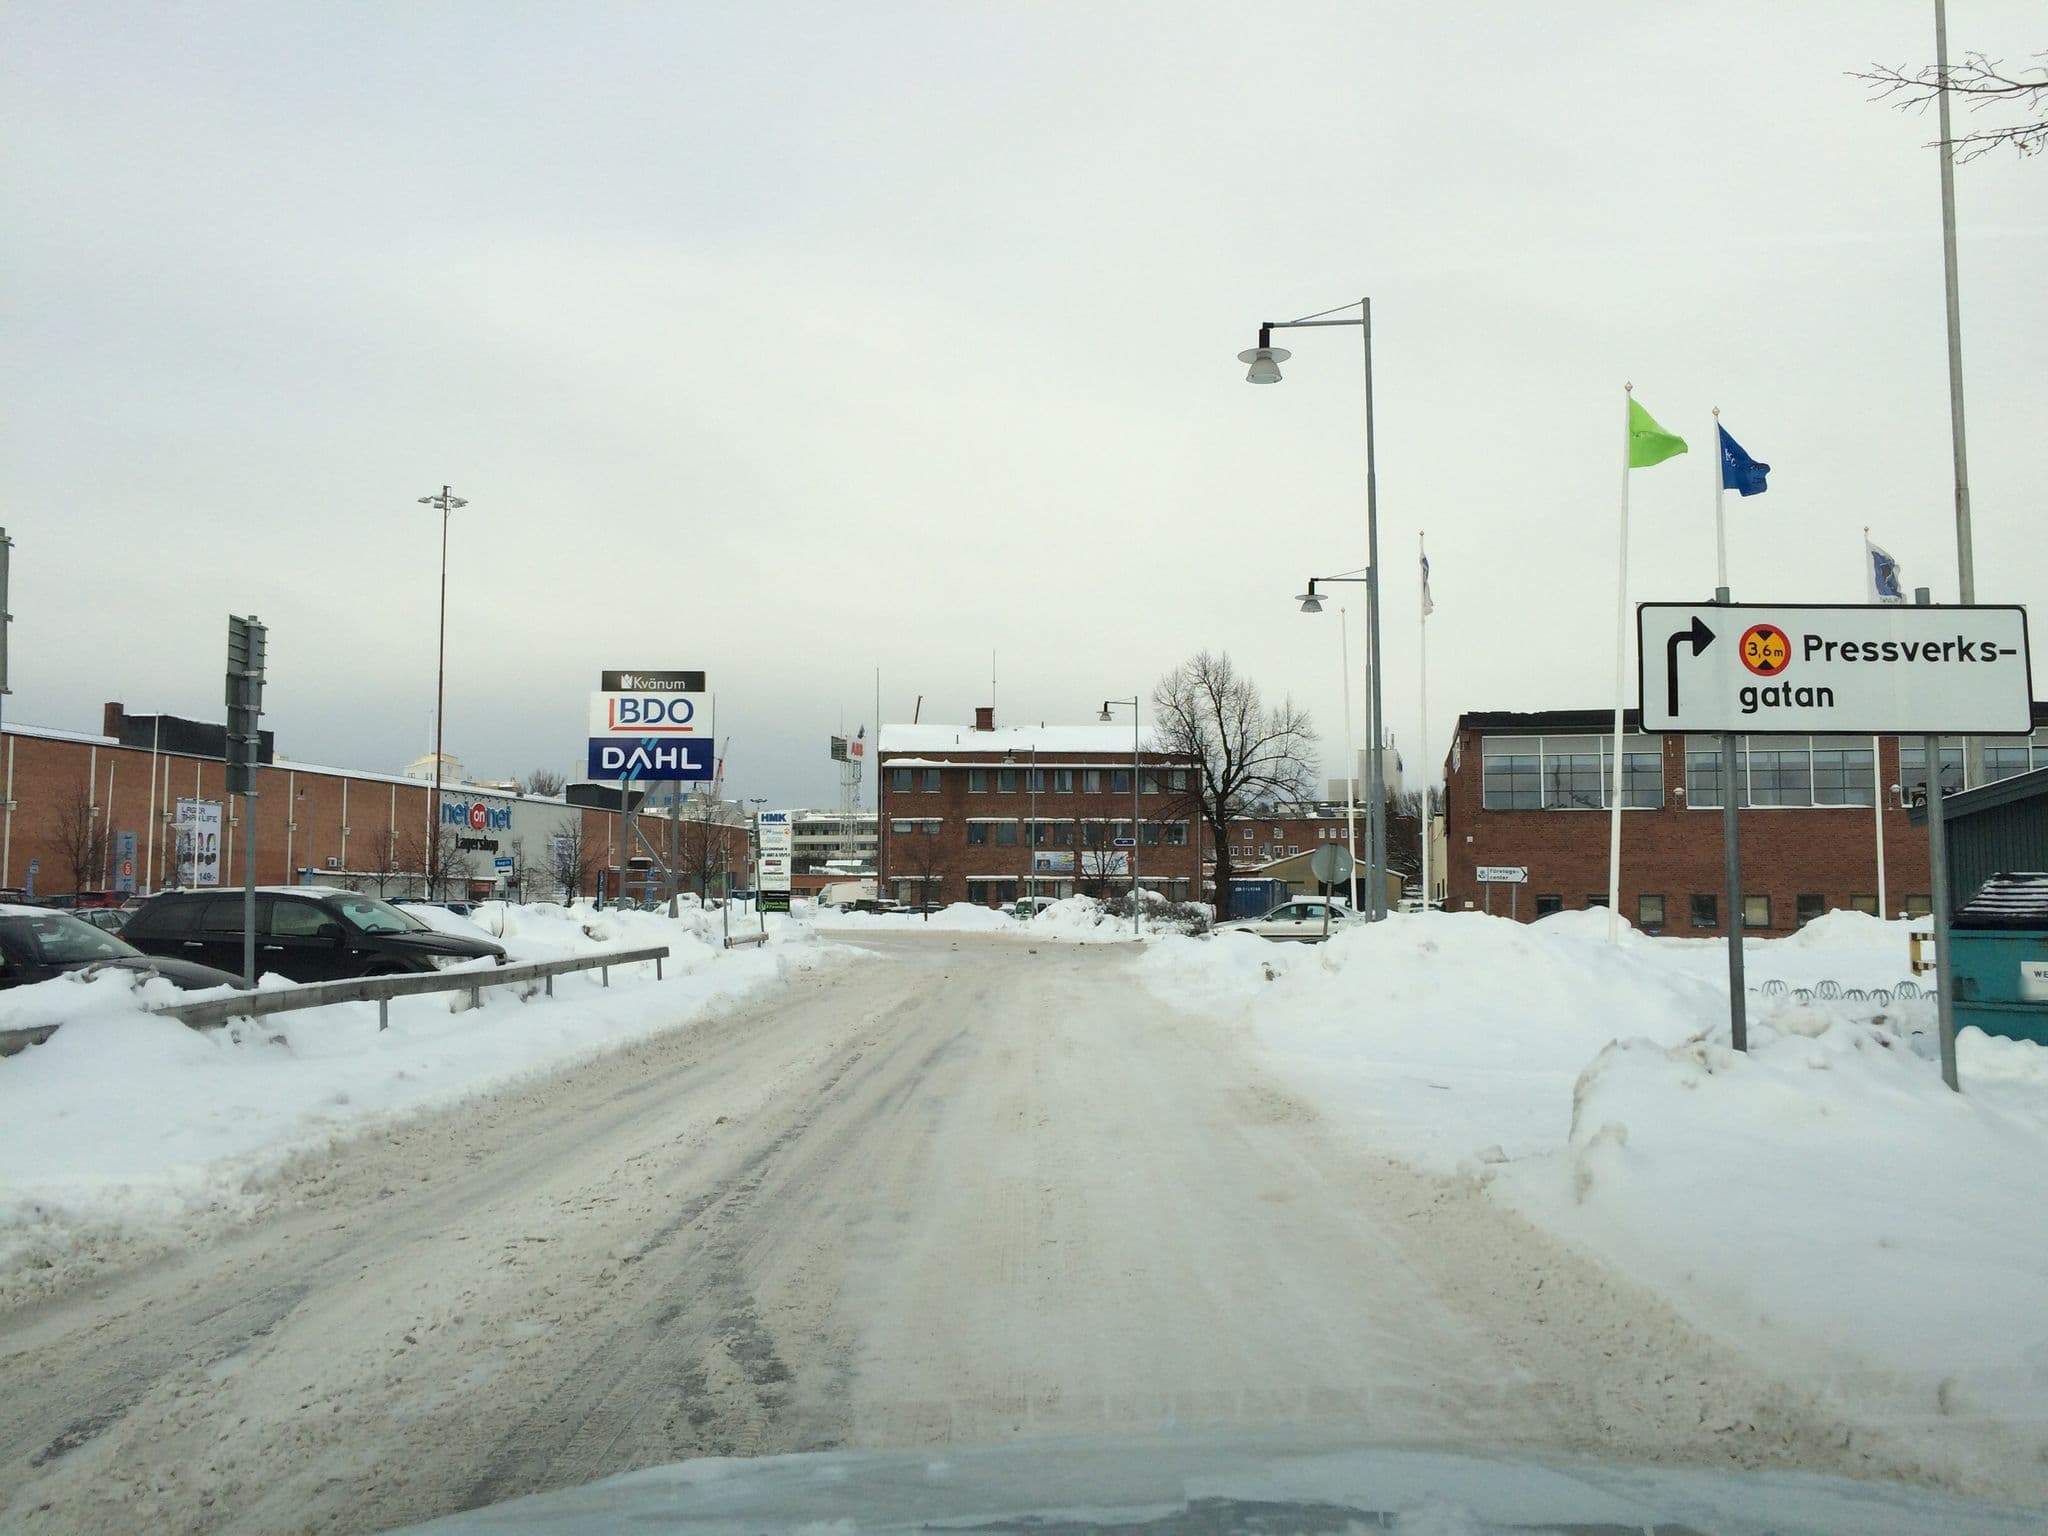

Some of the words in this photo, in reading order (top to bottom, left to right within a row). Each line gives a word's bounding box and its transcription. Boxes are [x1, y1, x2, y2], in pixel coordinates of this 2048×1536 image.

[1803, 634, 2018, 663] Pressverks-
[633, 676, 686, 690] Kvänum
[1738, 680, 1835, 714] gatan
[620, 698, 694, 724] BDO
[602, 746, 703, 770] DAHL
[761, 813, 787, 822] HMK
[455, 832, 499, 855] Lagershop
